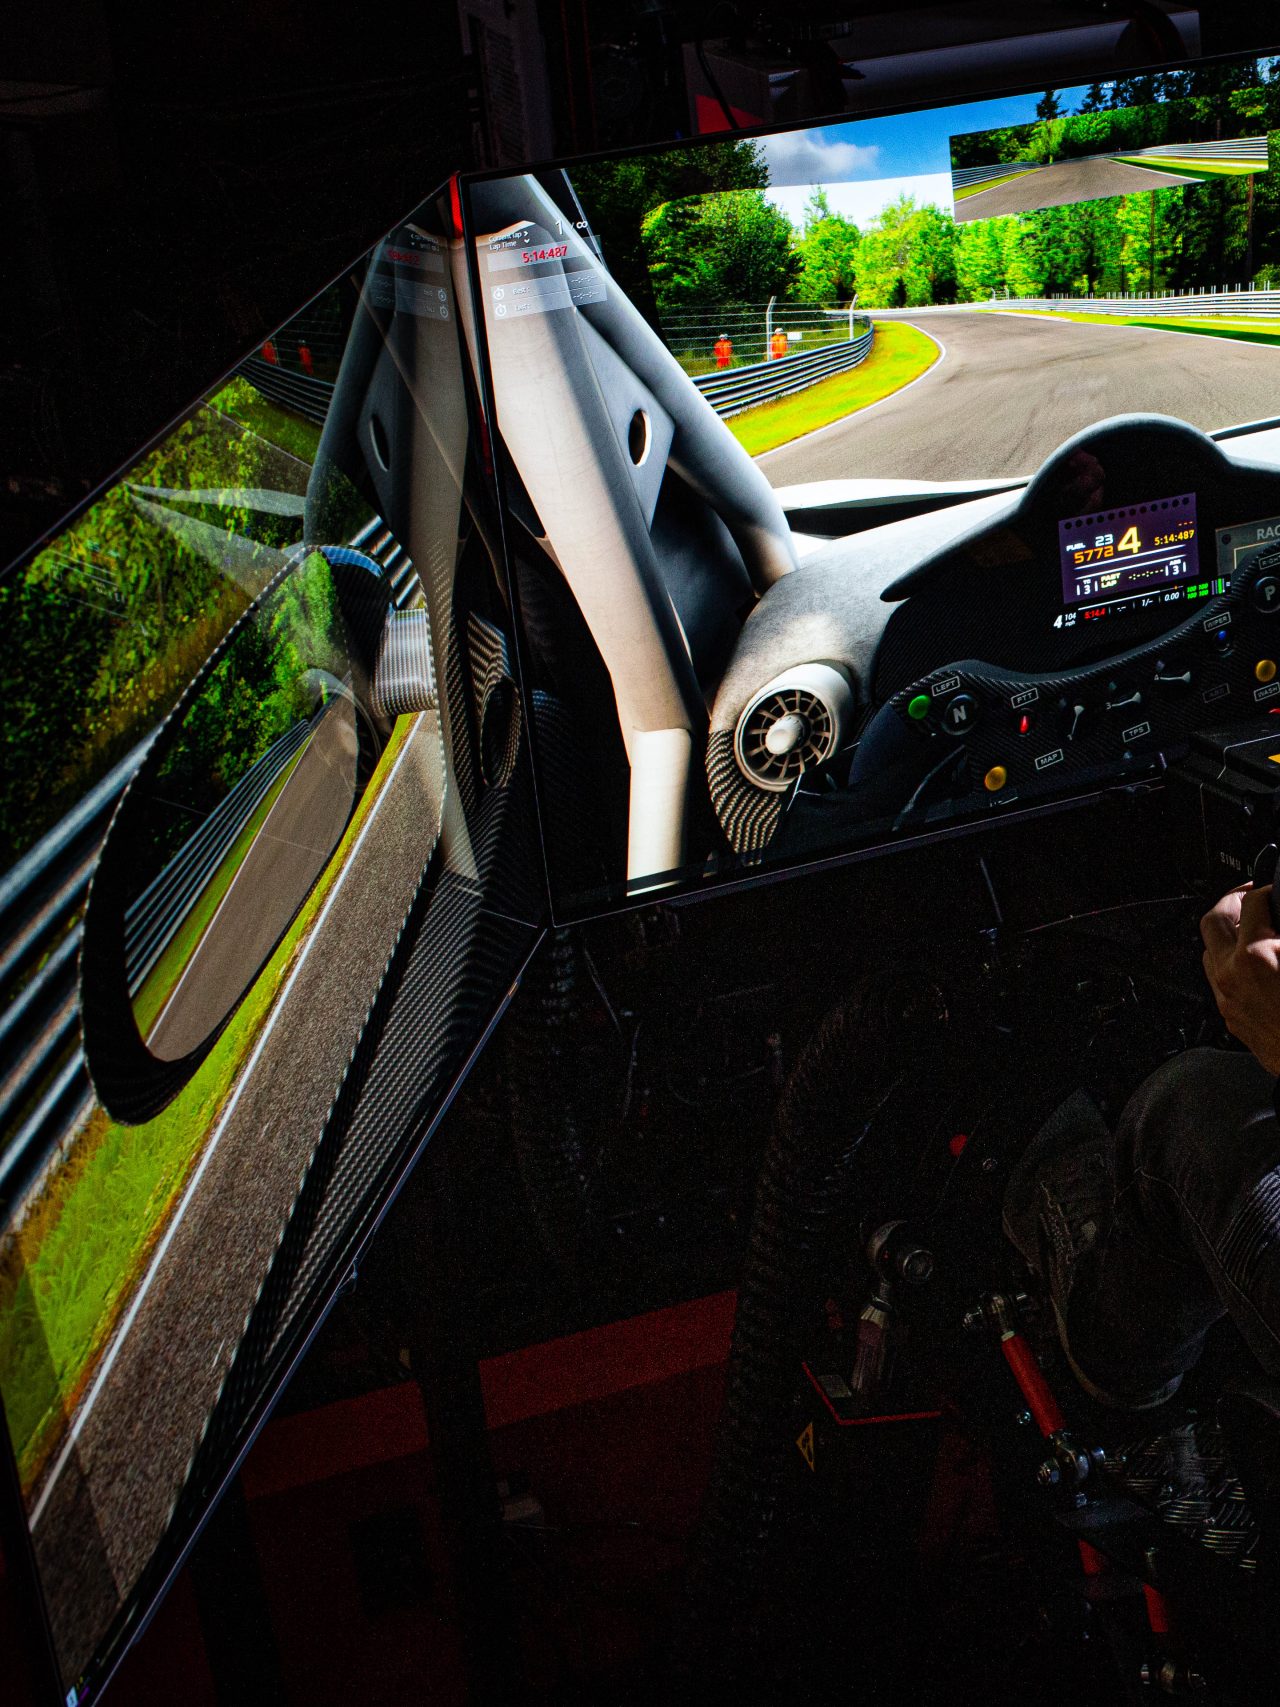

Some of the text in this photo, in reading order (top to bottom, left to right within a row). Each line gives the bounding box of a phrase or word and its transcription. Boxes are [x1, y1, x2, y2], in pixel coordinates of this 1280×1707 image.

[555, 220, 564, 235] 1
[522, 245, 568, 263] 5:14:487
[1095, 534, 1114, 547] 23
[1117, 526, 1142, 554] 4
[1154, 529, 1195, 546] 5:14:487
[1073, 545, 1114, 564] 5772
[1084, 585, 1091, 594] 3
[1264, 585, 1276, 600] P
[1053, 614, 1063, 629] 4
[935, 680, 956, 693] LEFT
[953, 705, 967, 723] N
[1040, 753, 1058, 765] MAP
